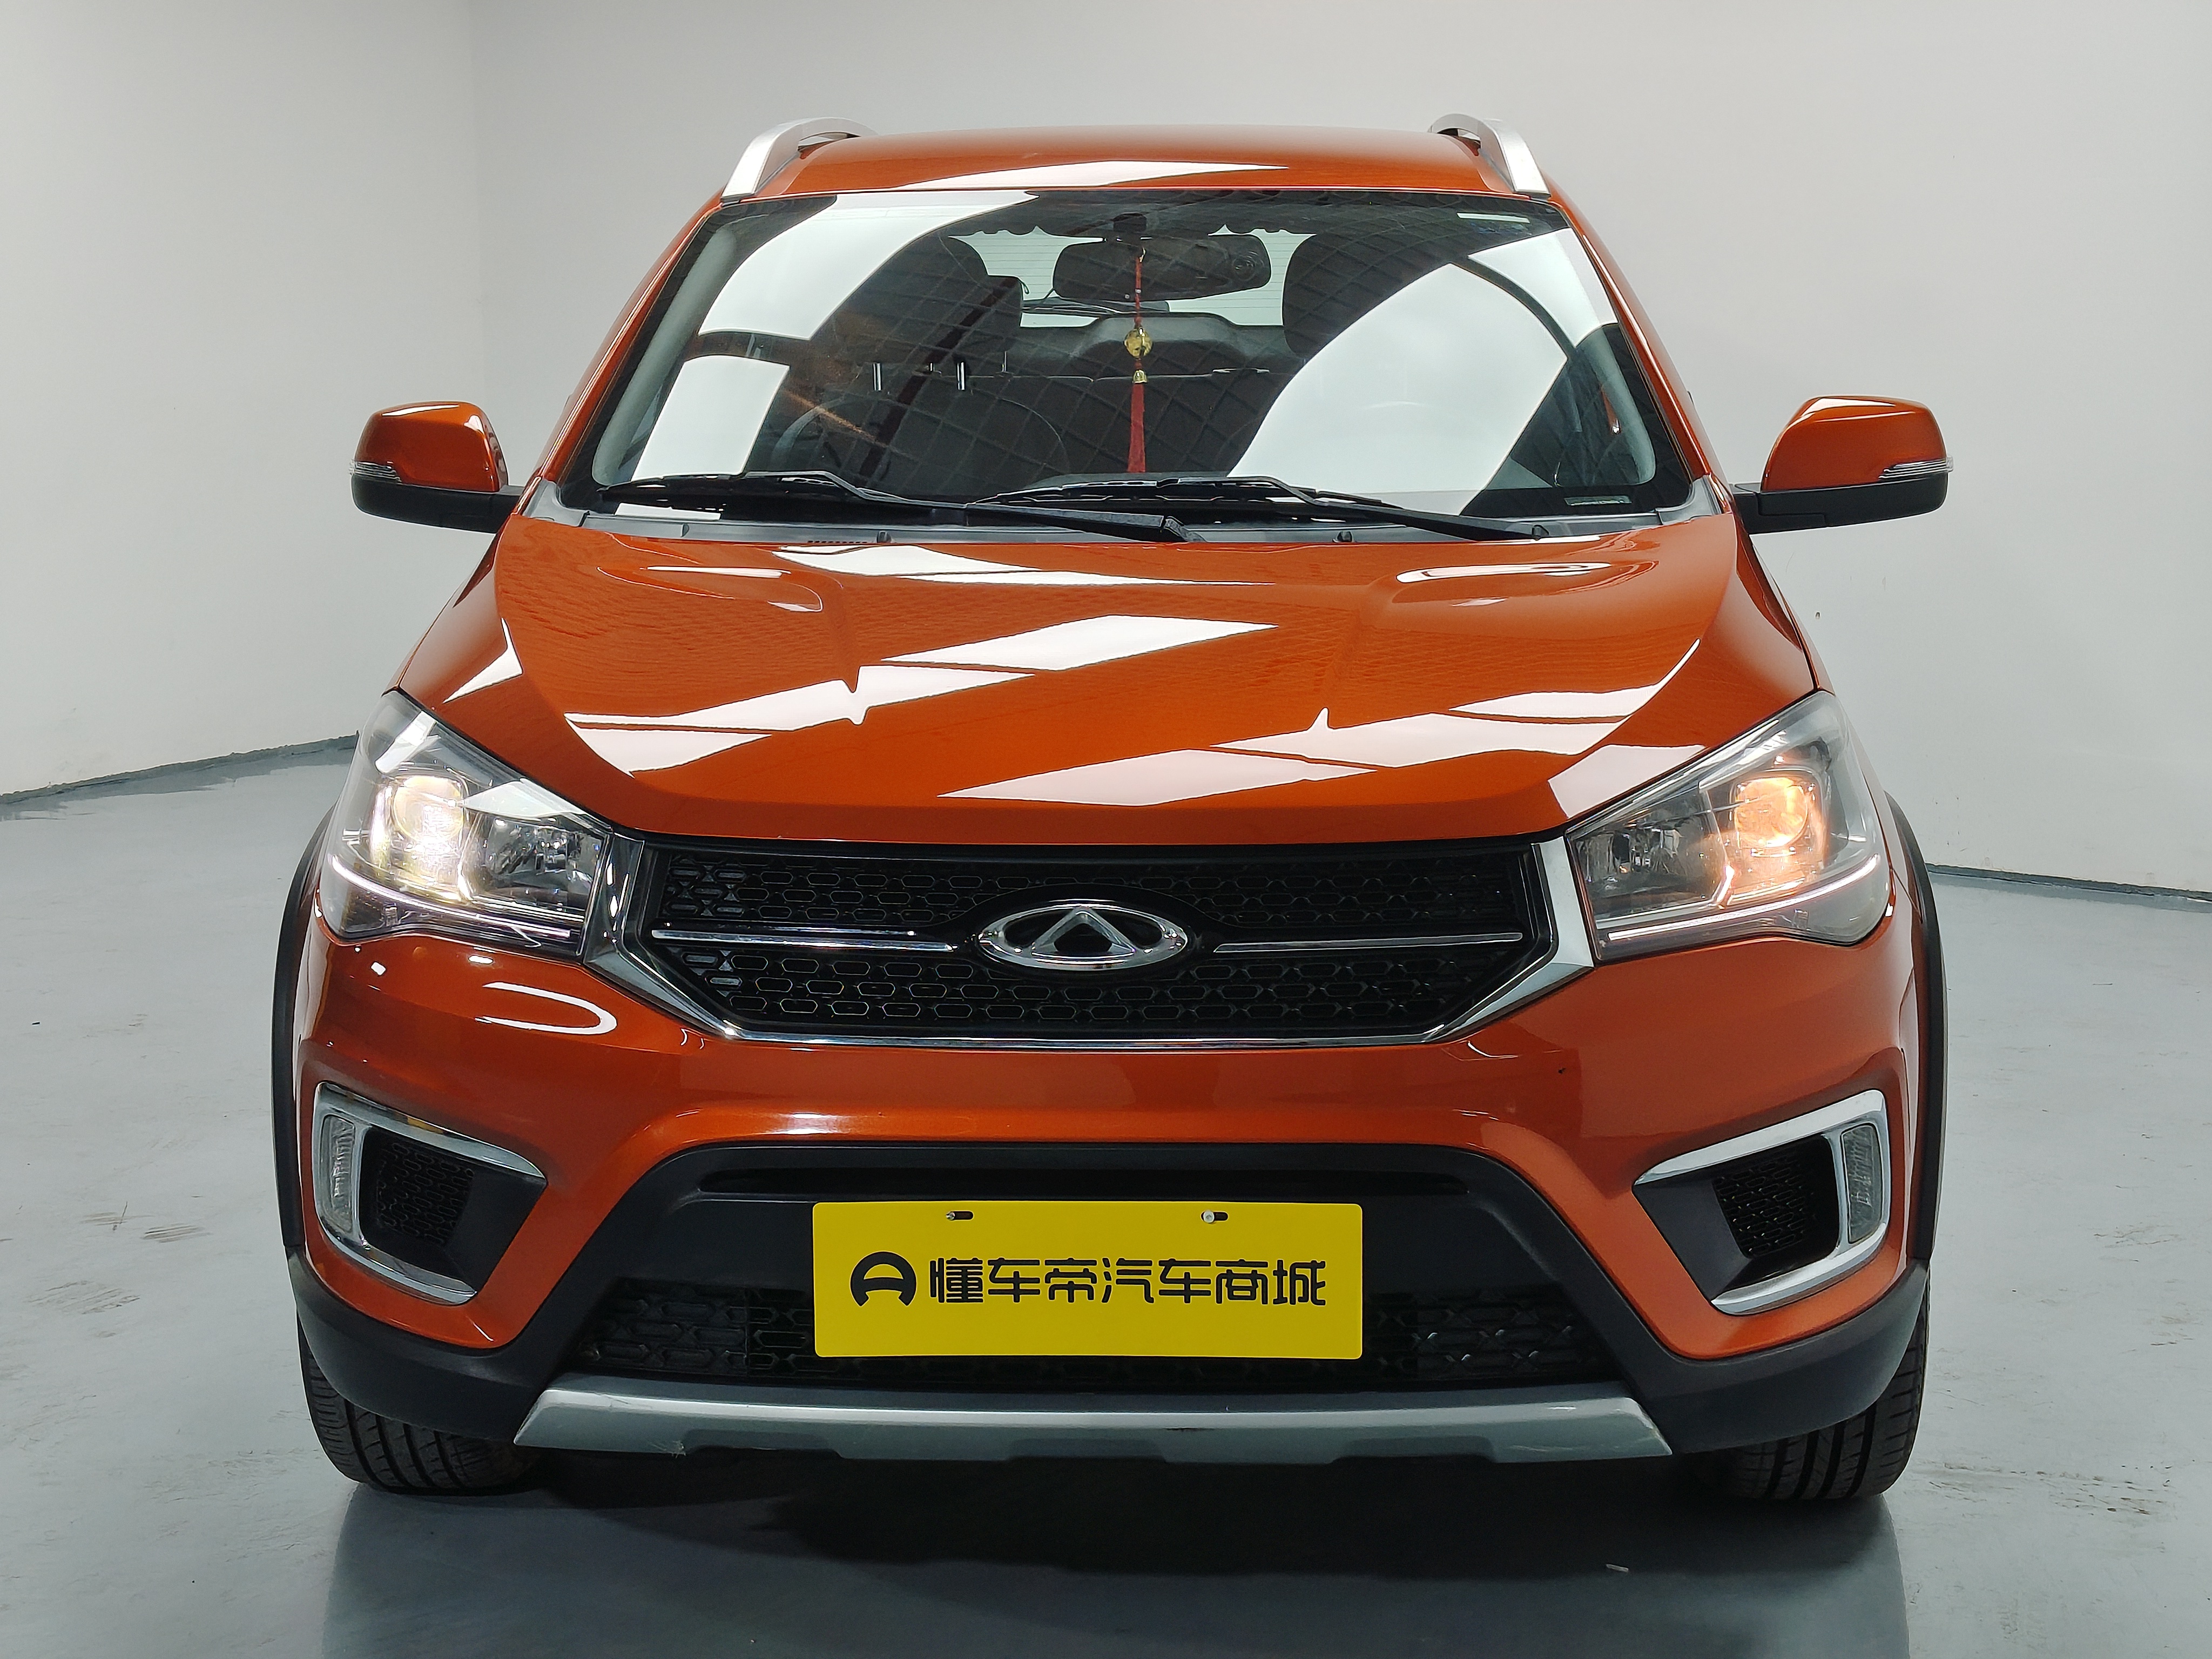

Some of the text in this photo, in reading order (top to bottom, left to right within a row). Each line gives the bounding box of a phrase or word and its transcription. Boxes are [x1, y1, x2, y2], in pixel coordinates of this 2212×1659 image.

[929, 1257, 1326, 1306] 懂车帝汽车商城
